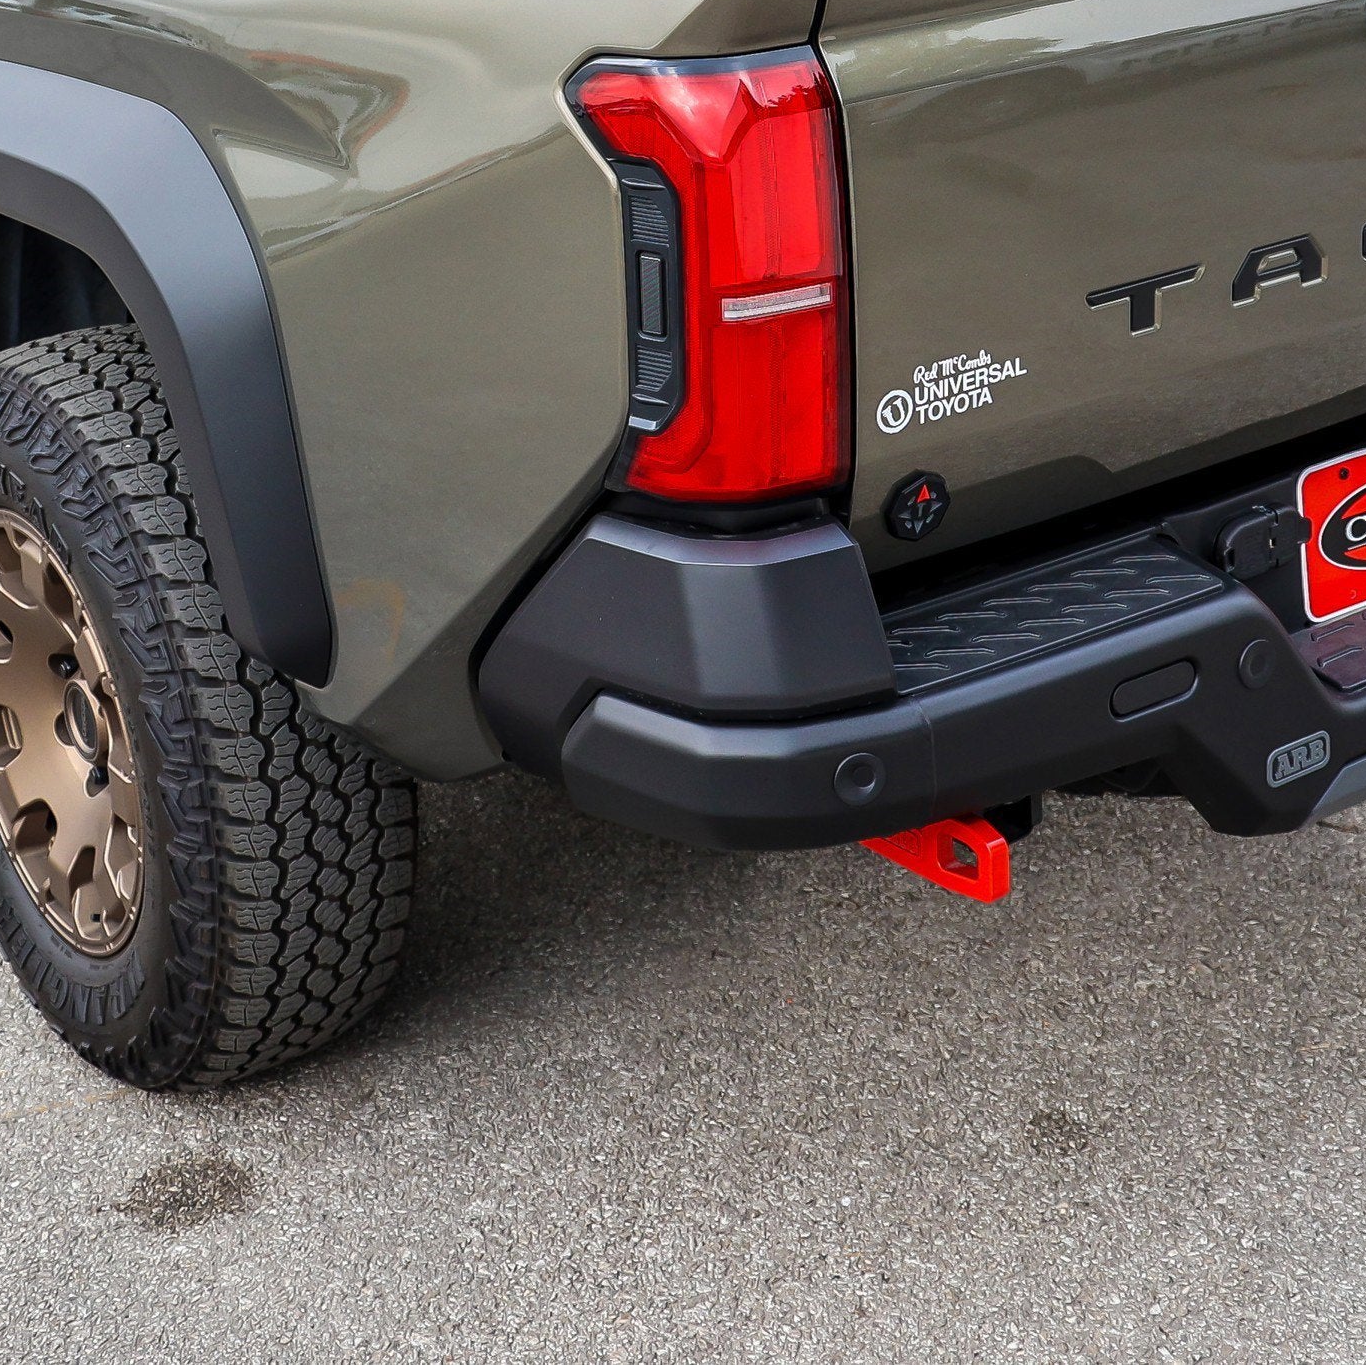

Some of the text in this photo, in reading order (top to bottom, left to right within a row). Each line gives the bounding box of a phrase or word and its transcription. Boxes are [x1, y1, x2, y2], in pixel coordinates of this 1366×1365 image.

[913, 362, 938, 387] Red
[915, 357, 1028, 405] UNIVERSAL
[915, 386, 993, 425] TOYOTA
[1275, 739, 1325, 780] ARB
